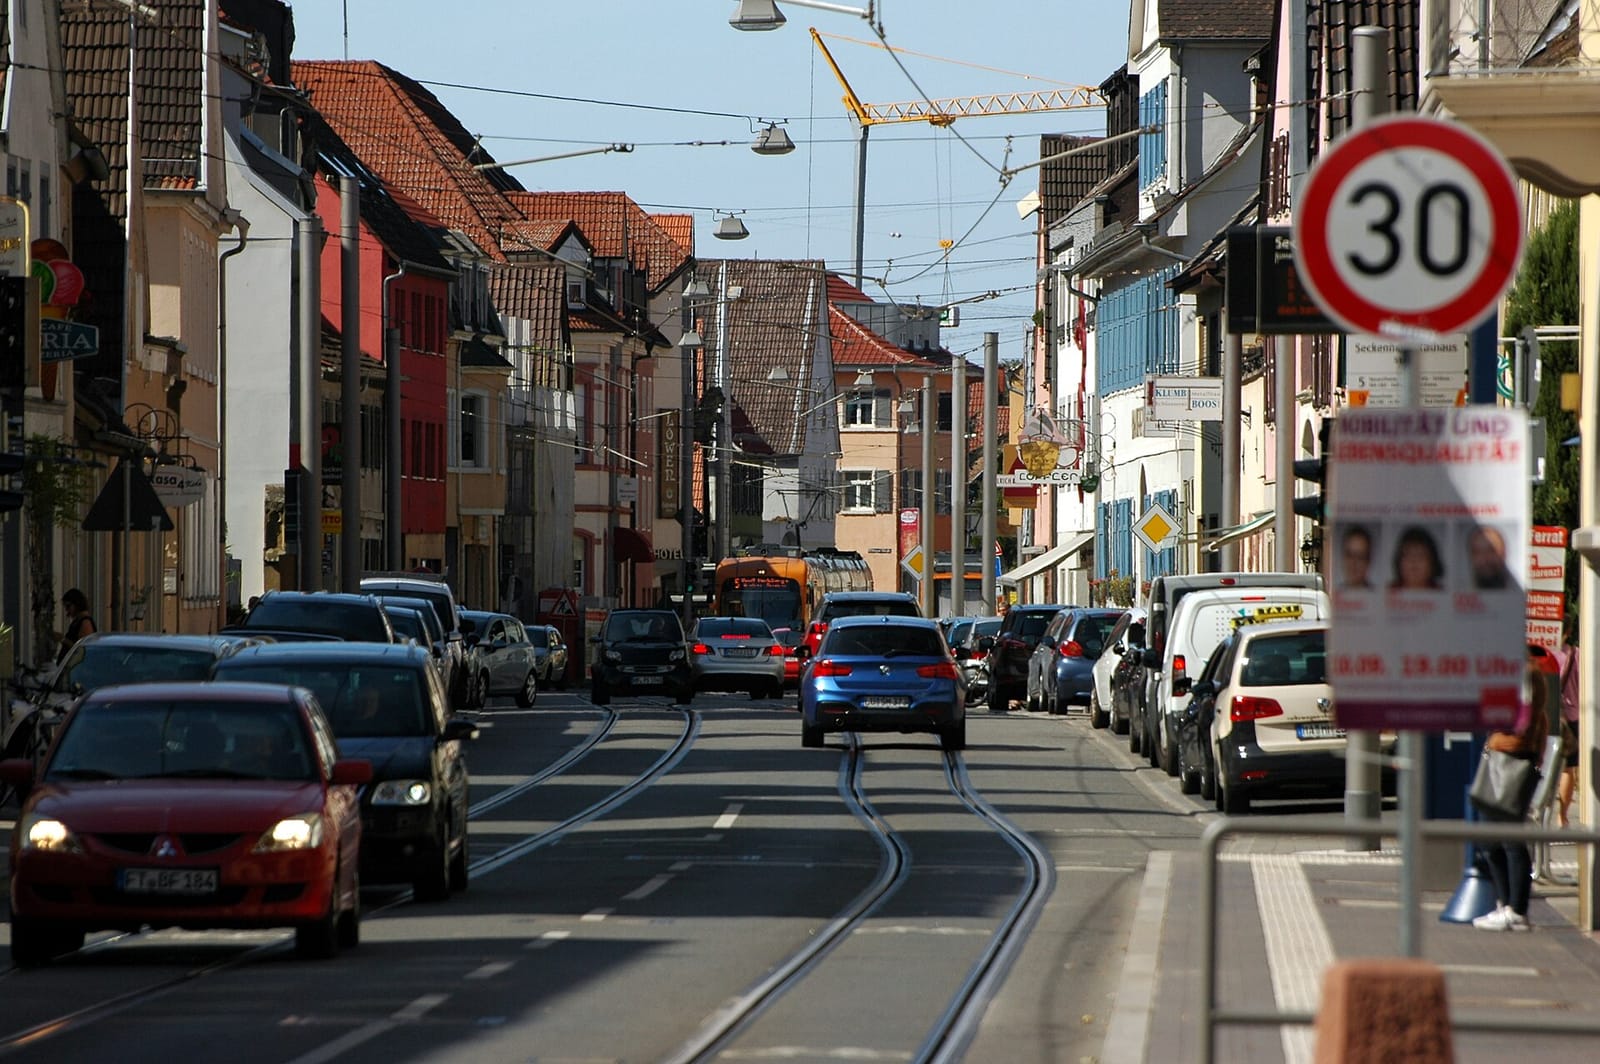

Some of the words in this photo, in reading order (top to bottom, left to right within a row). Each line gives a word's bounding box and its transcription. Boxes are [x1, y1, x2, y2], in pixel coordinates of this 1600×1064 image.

[1348, 181, 1471, 277] 30
[41, 332, 92, 350] RIA
[1454, 412, 1511, 434] UND
[1263, 605, 1295, 614] TAXI
